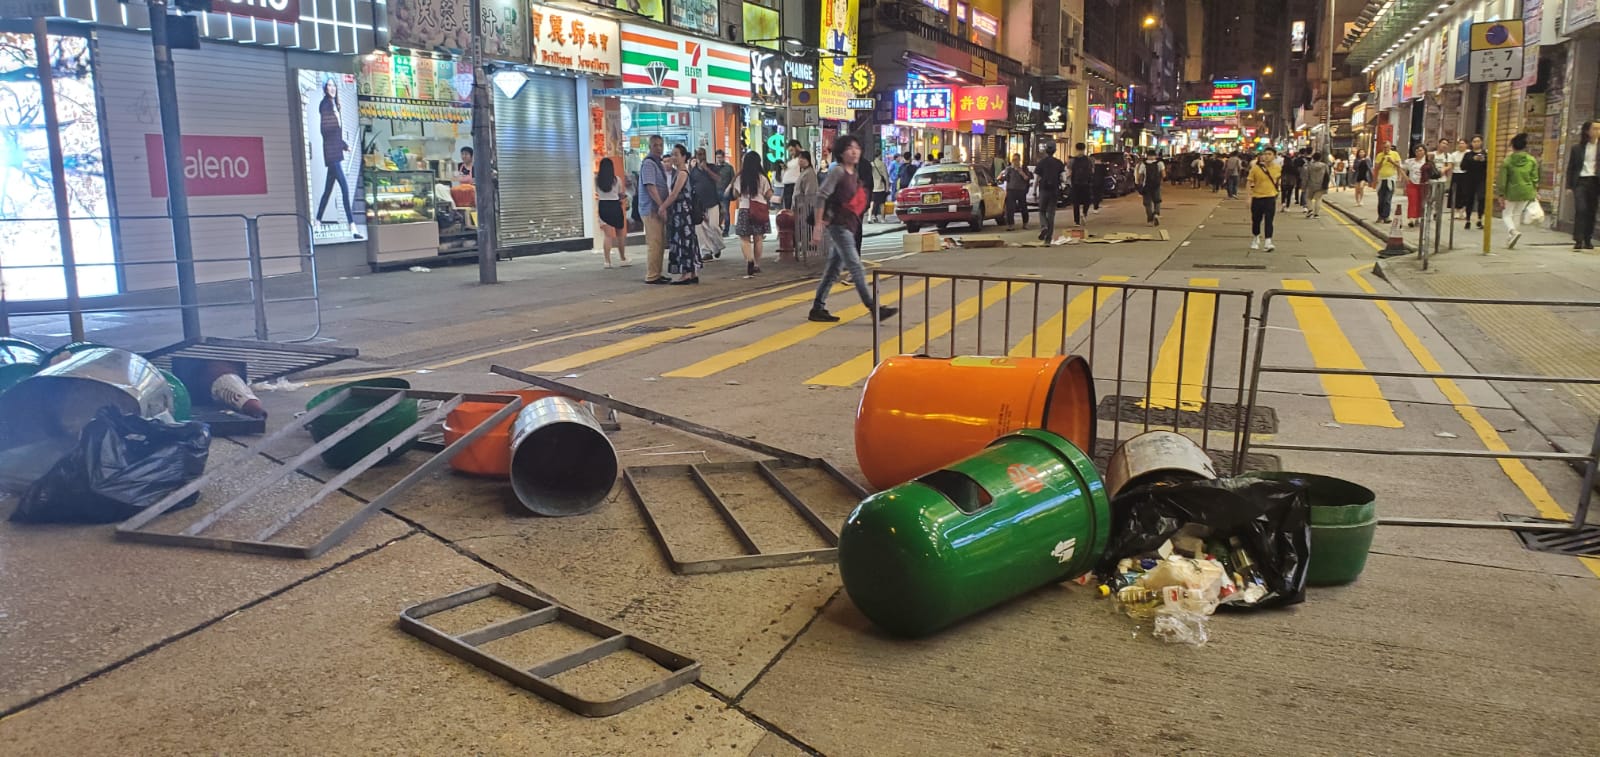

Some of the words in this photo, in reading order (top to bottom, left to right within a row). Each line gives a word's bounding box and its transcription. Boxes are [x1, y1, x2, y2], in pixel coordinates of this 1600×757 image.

[541, 50, 573, 66] Brilliant
[578, 56, 610, 74] Jewellery
[1504, 49, 1513, 61] 7
[685, 41, 701, 94] 7
[784, 60, 813, 81] CHANGE
[1503, 67, 1512, 78] 7
[847, 98, 873, 110] CHANGE
[959, 95, 1005, 112] 許留山
[183, 148, 250, 179] aleno
